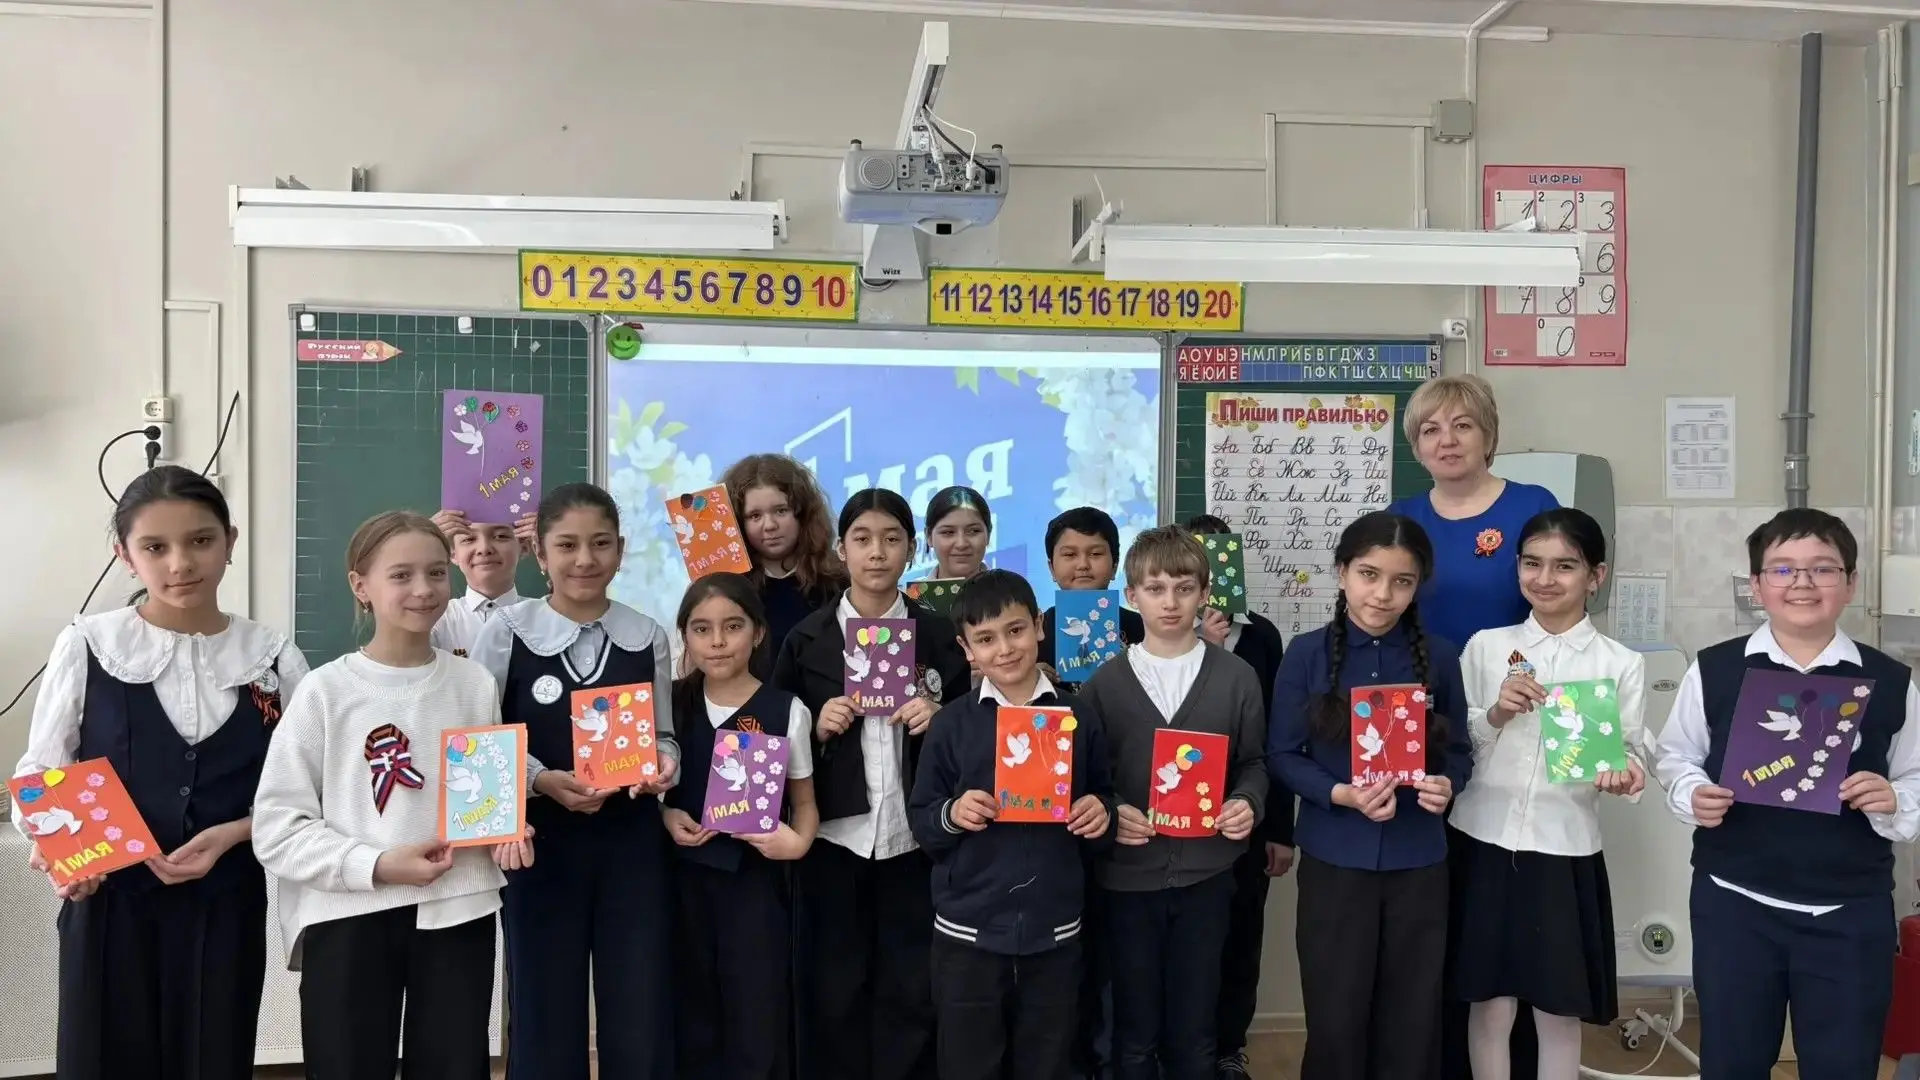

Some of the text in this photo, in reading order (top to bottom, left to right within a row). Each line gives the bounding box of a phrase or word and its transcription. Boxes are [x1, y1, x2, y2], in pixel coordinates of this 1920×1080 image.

[1529, 174, 1583, 185] ЦИФРЫ
[1496, 192, 1585, 203] 1 2 3
[1559, 200, 1576, 230] 2
[1597, 200, 1615, 231] 3
[1597, 243, 1615, 273] 6
[532, 264, 846, 308] 0 1 2 3 4 5 6 7 8 9 10
[1578, 277, 1585, 286] 9
[940, 282, 1232, 318] 11 12 13 14 15 16 17 18 19 20
[1556, 286, 1575, 314] 8
[1598, 284, 1616, 314] 9
[1538, 319, 1545, 329] 0
[1556, 326, 1575, 357] 0
[1213, 435, 1388, 461] Аа Бб Вв Гг Дд
[480, 466, 519, 498] 1 МАЯ
[1213, 459, 1229, 478] Ее
[1277, 460, 1315, 478] Жж
[1330, 461, 1352, 486] Зз
[1363, 460, 1388, 479] Ии
[1212, 481, 1388, 503] Йй Кк Лл Мм Нн
[1243, 507, 1268, 525] Пп
[1287, 507, 1308, 532] Рр
[1325, 507, 1342, 526] Сс
[1244, 531, 1270, 555] Фф
[1284, 531, 1312, 550] Хх
[1281, 579, 1313, 597] Юю
[1209, 595, 1227, 606] АЯ
[1262, 602, 1332, 614] 2 3 4
[1292, 621, 1300, 632] 8
[1059, 657, 1067, 672] 1
[861, 696, 895, 708] МАЯ
[583, 752, 641, 780] 1 МАЯ
[1362, 766, 1370, 784] 1
[1551, 764, 1568, 777] 1
[1742, 769, 1756, 788] 1
[452, 810, 466, 832] 1
[706, 800, 750, 824] 1 МАЯ
[1147, 808, 1191, 829] 1 МАЯ
[53, 841, 114, 877] 1 МАЯ
